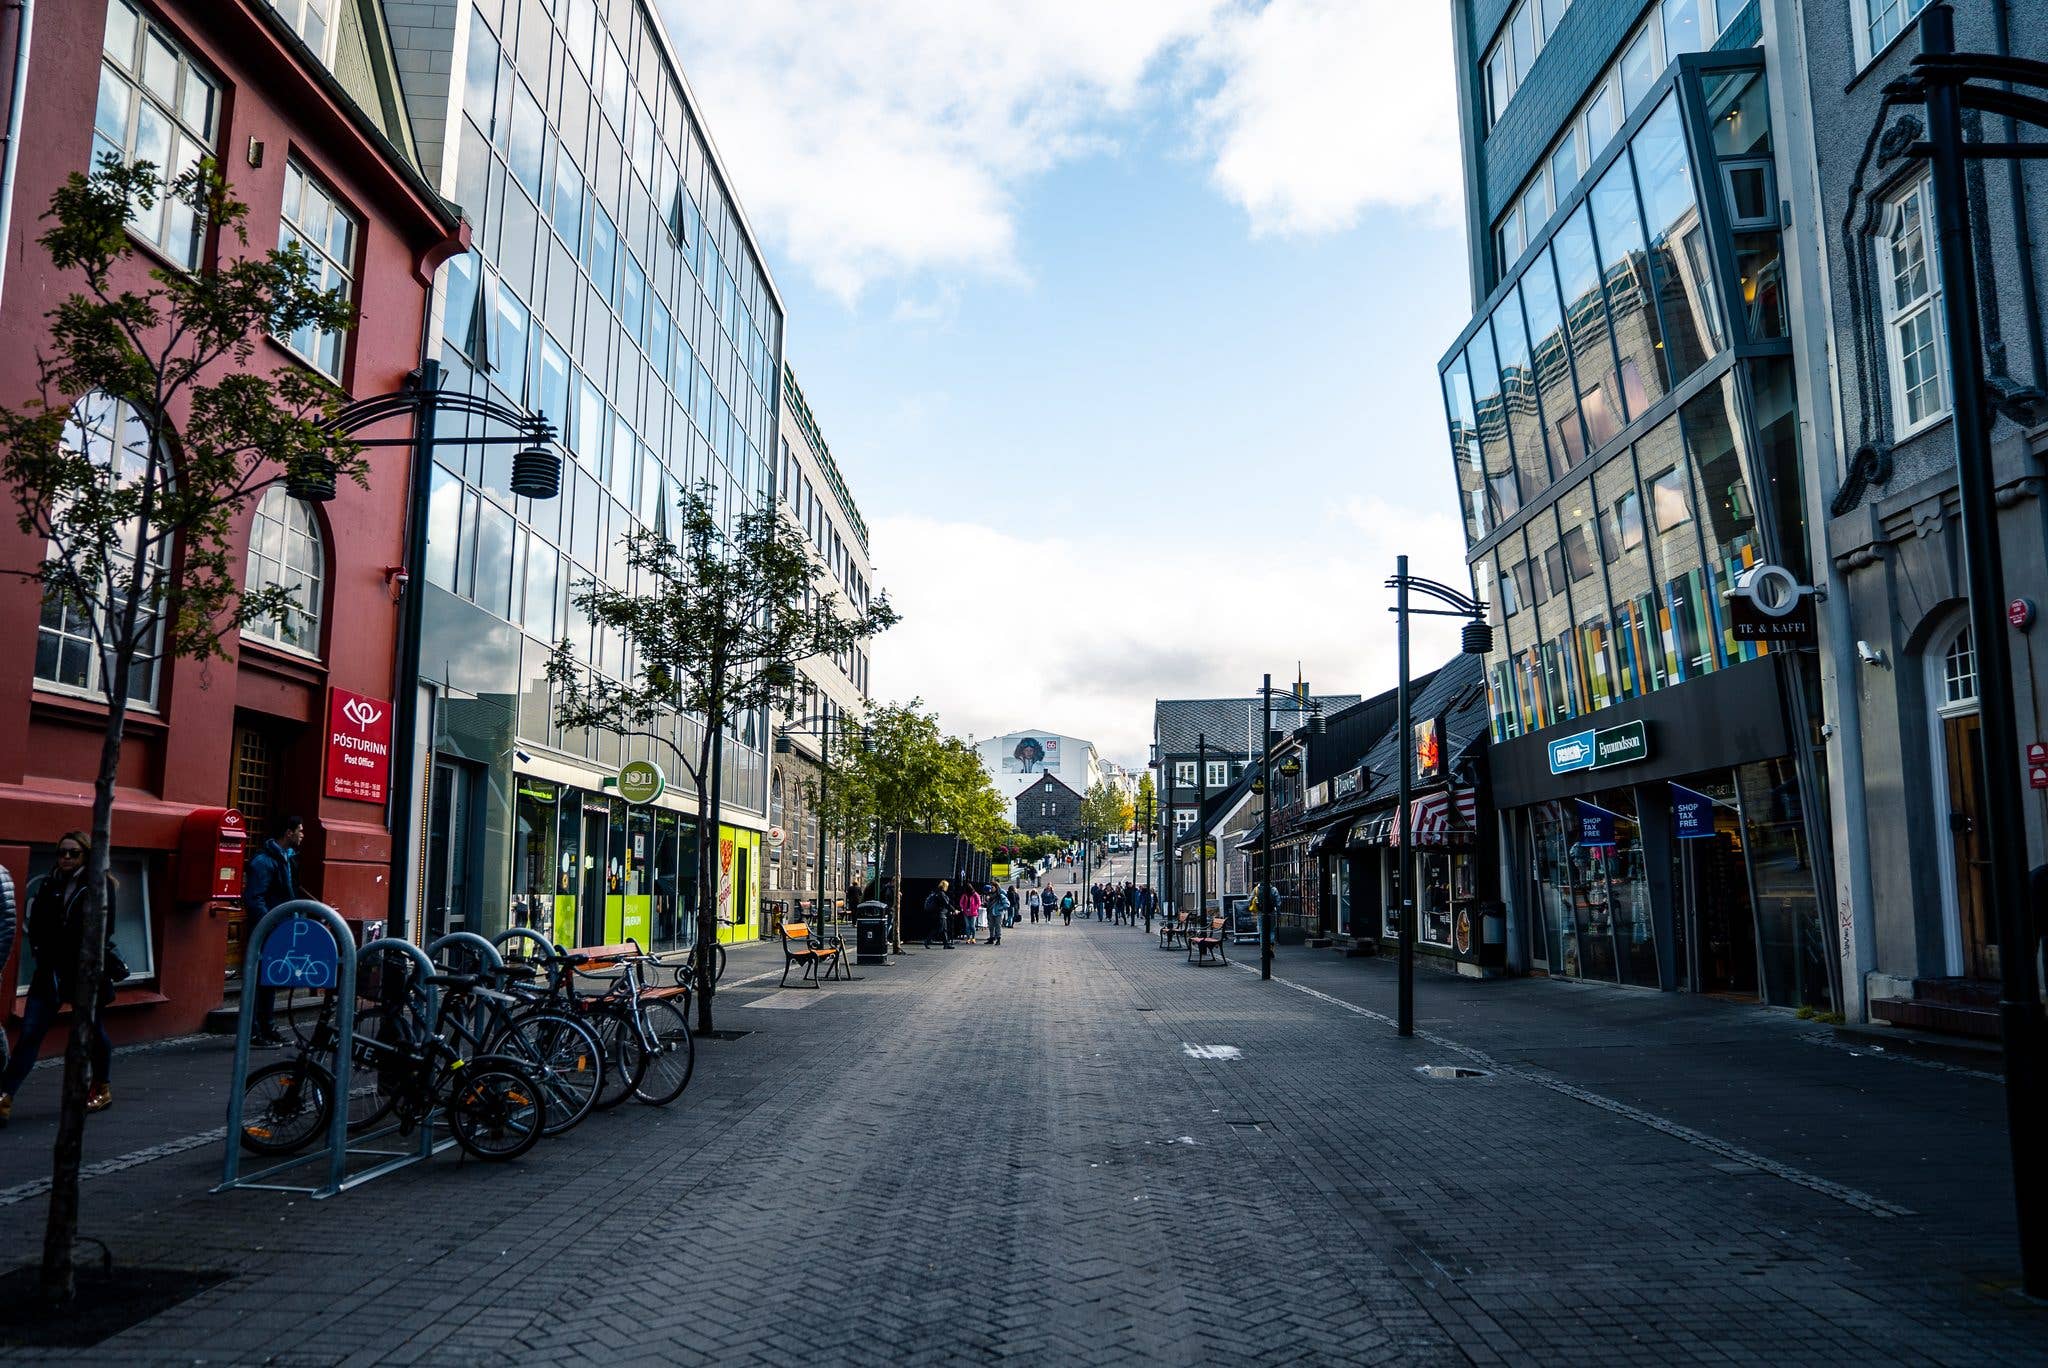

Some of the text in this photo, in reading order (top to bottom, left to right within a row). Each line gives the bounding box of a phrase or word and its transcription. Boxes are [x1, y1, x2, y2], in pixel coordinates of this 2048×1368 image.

[1739, 622, 1806, 634] TE & KAFFI
[333, 733, 387, 756] PÓSTURINN
[1047, 741, 1056, 749] 66
[1599, 736, 1640, 758] Eymundsson
[344, 753, 375, 768] Post Office
[1678, 804, 1698, 812] SHOP
[1583, 817, 1601, 825] SHOP
[1679, 819, 1698, 828] FREE
[293, 921, 309, 948] P
[328, 1032, 376, 1061] MTE
